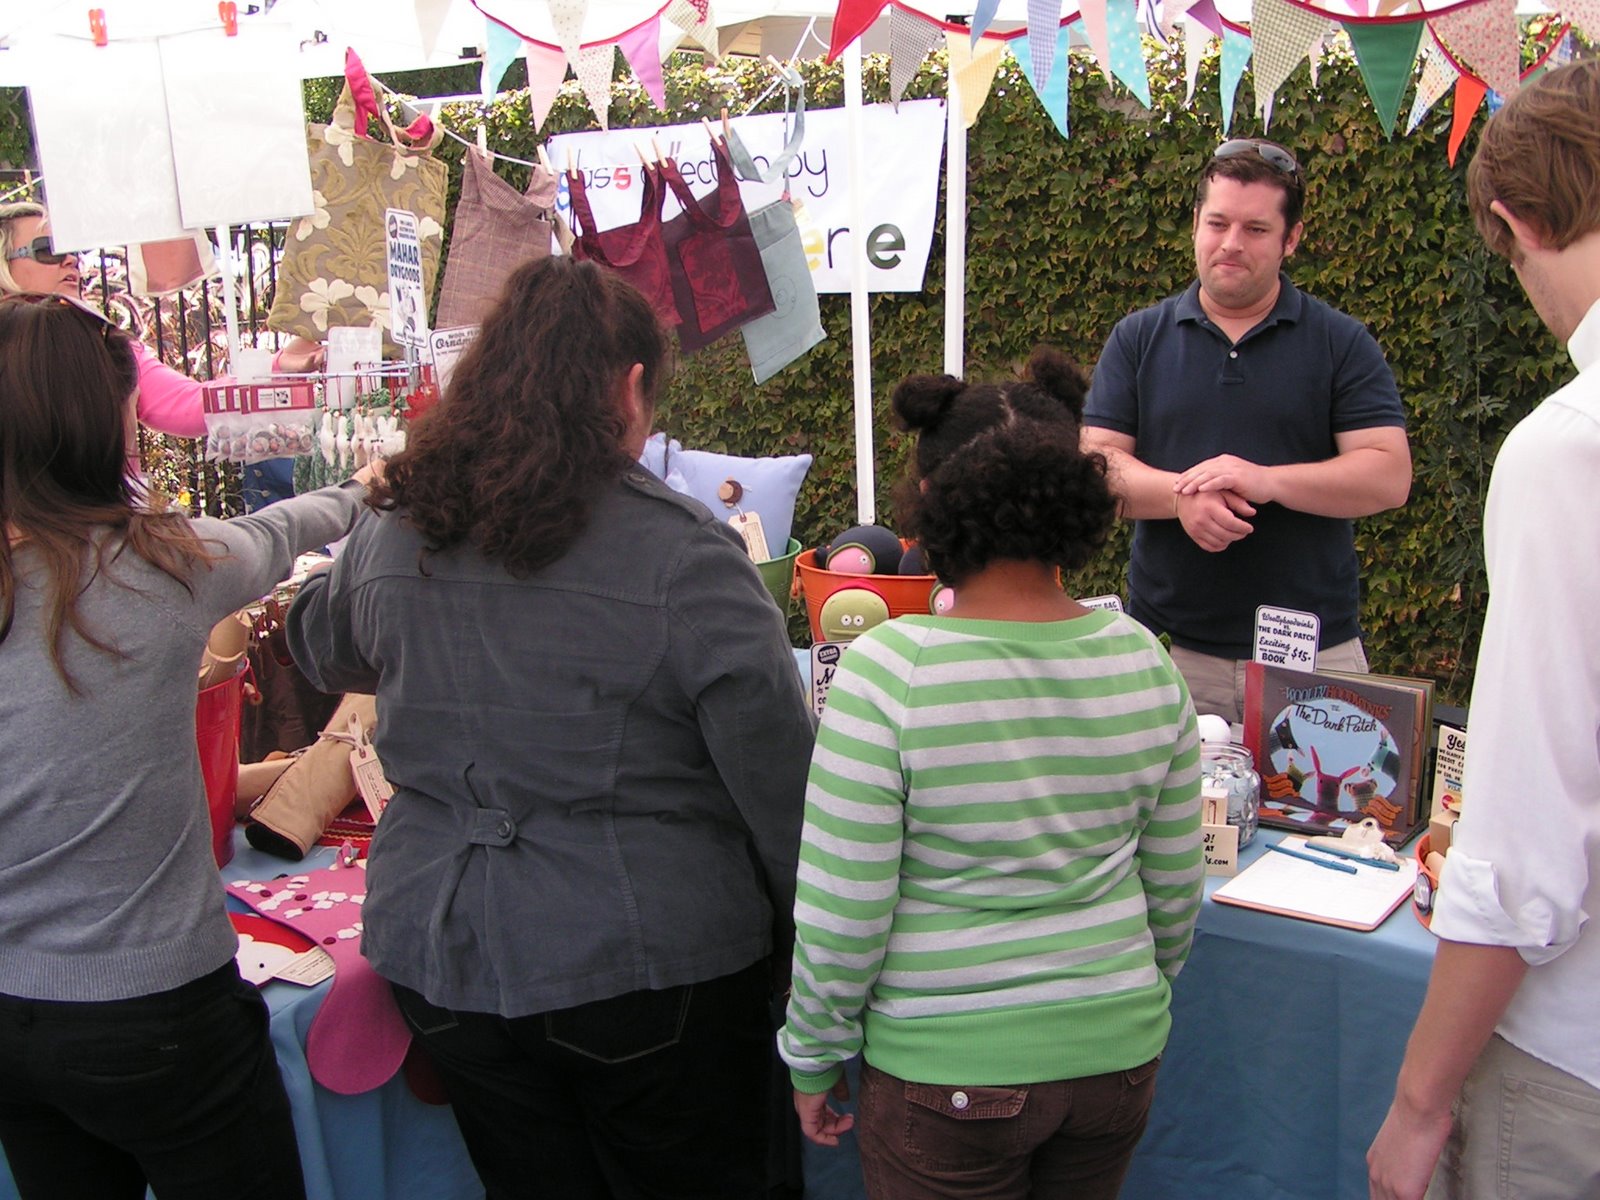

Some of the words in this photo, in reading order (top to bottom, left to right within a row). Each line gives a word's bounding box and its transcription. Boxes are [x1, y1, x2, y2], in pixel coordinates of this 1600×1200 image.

[389, 242, 420, 267] MAHAR
[390, 263, 420, 284] DRYGOODS
[1258, 625, 1272, 634] THE
[1273, 628, 1292, 638] DARK
[1293, 632, 1316, 642] PATCH
[1259, 636, 1292, 652] Exciting
[1262, 653, 1285, 664] BOOK
[1292, 703, 1313, 722] The
[1312, 708, 1346, 732] Dark
[1347, 715, 1377, 733] Patch
[1439, 755, 1455, 764] CREDIT
[1447, 784, 1461, 792] VISA
